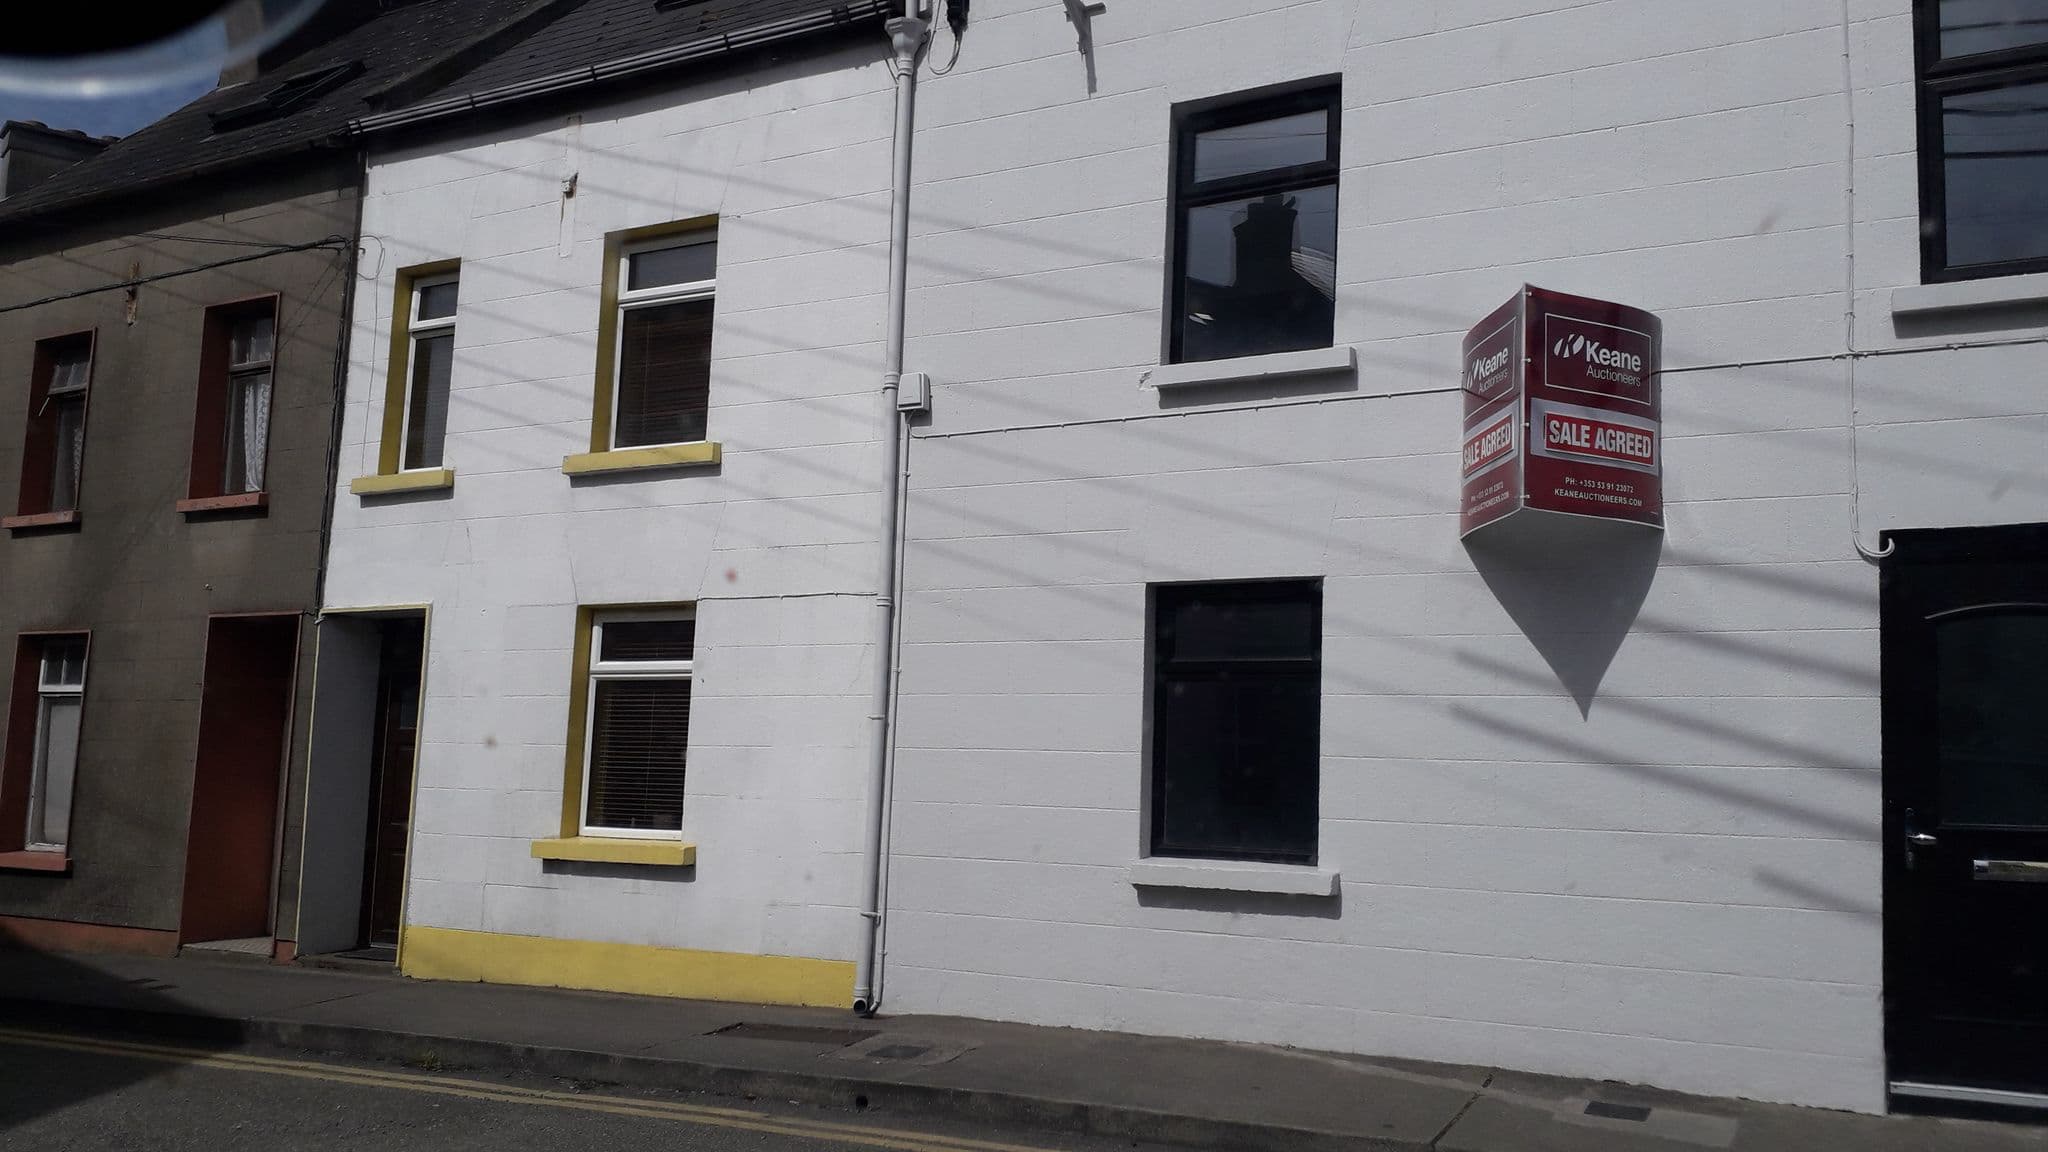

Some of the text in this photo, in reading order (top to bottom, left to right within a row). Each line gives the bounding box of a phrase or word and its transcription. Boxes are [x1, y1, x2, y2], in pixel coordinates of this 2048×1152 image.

[1479, 347, 1509, 380] Keane
[1586, 340, 1641, 372] Keane
[1586, 364, 1641, 387] Auctioneers
[1463, 422, 1511, 470] SALE AGREED
[1549, 420, 1651, 458] SALE AGREED
[1554, 488, 1643, 507] KEANEAUCTIONEERS.COM
[1565, 476, 1578, 486] PH:
[1580, 479, 1596, 488] +353
[1597, 481, 1605, 490] 53
[1606, 482, 1614, 490] 91
